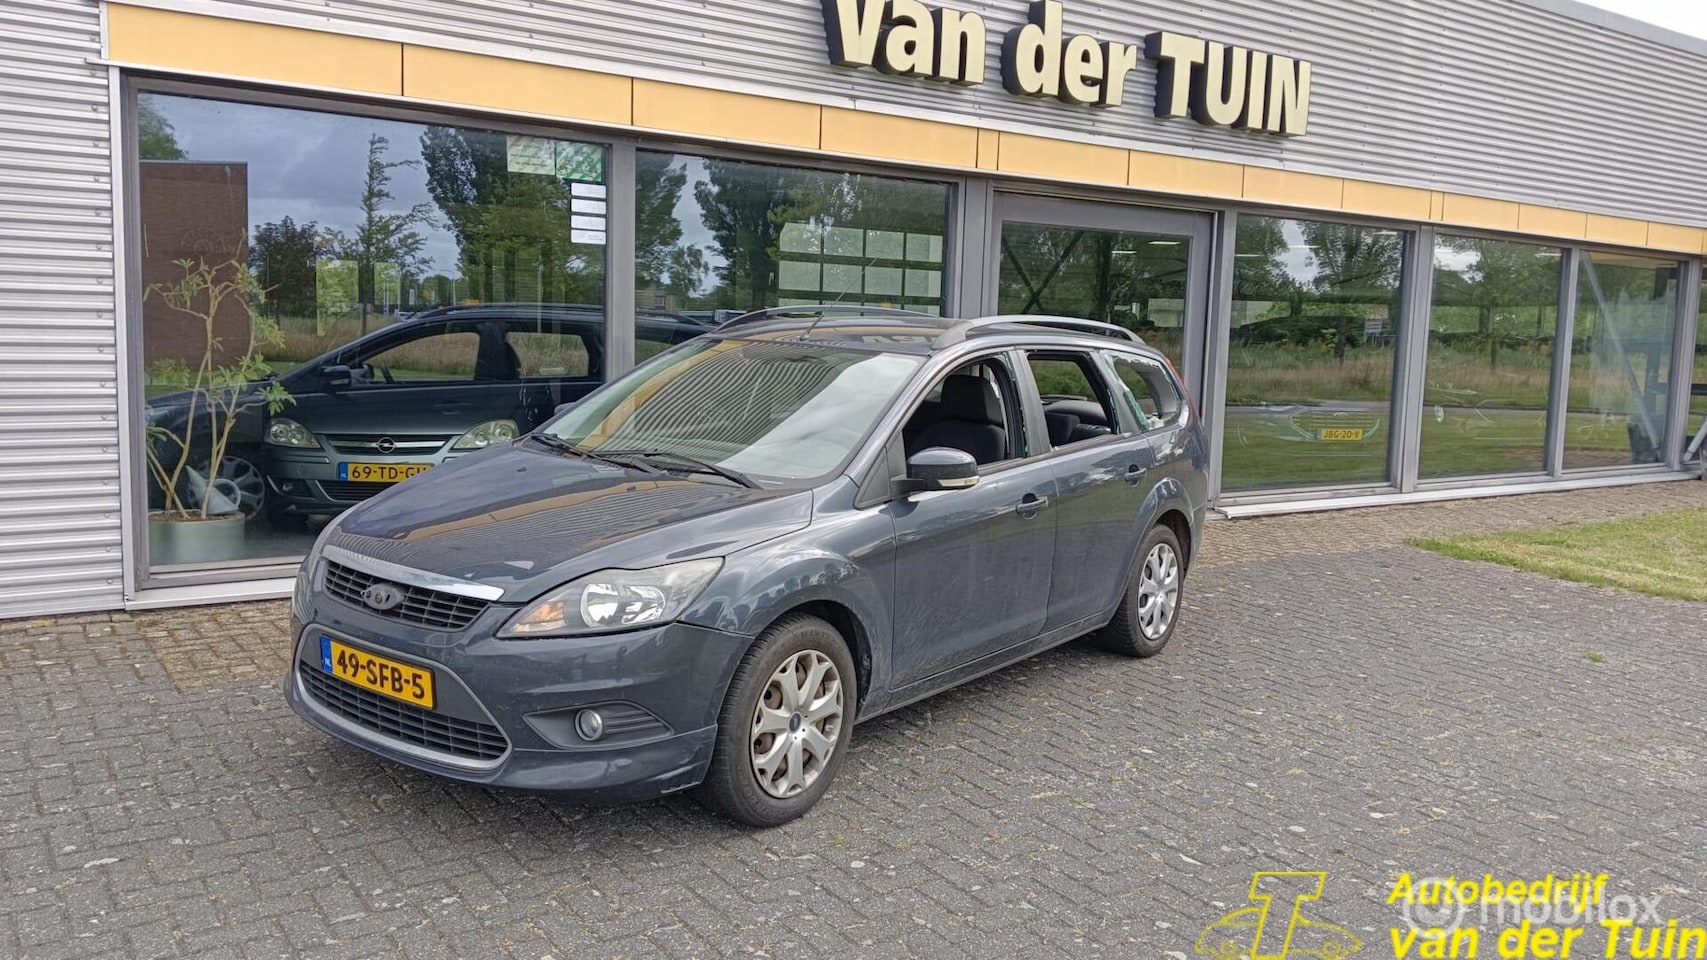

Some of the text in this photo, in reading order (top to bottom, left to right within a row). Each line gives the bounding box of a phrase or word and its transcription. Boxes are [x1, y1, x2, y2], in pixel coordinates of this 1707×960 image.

[1001, 0, 1137, 108] der
[1145, 31, 1312, 137] TUIN
[351, 466, 427, 480] 69-TD-G
[337, 649, 425, 699] 49-SFB-5
